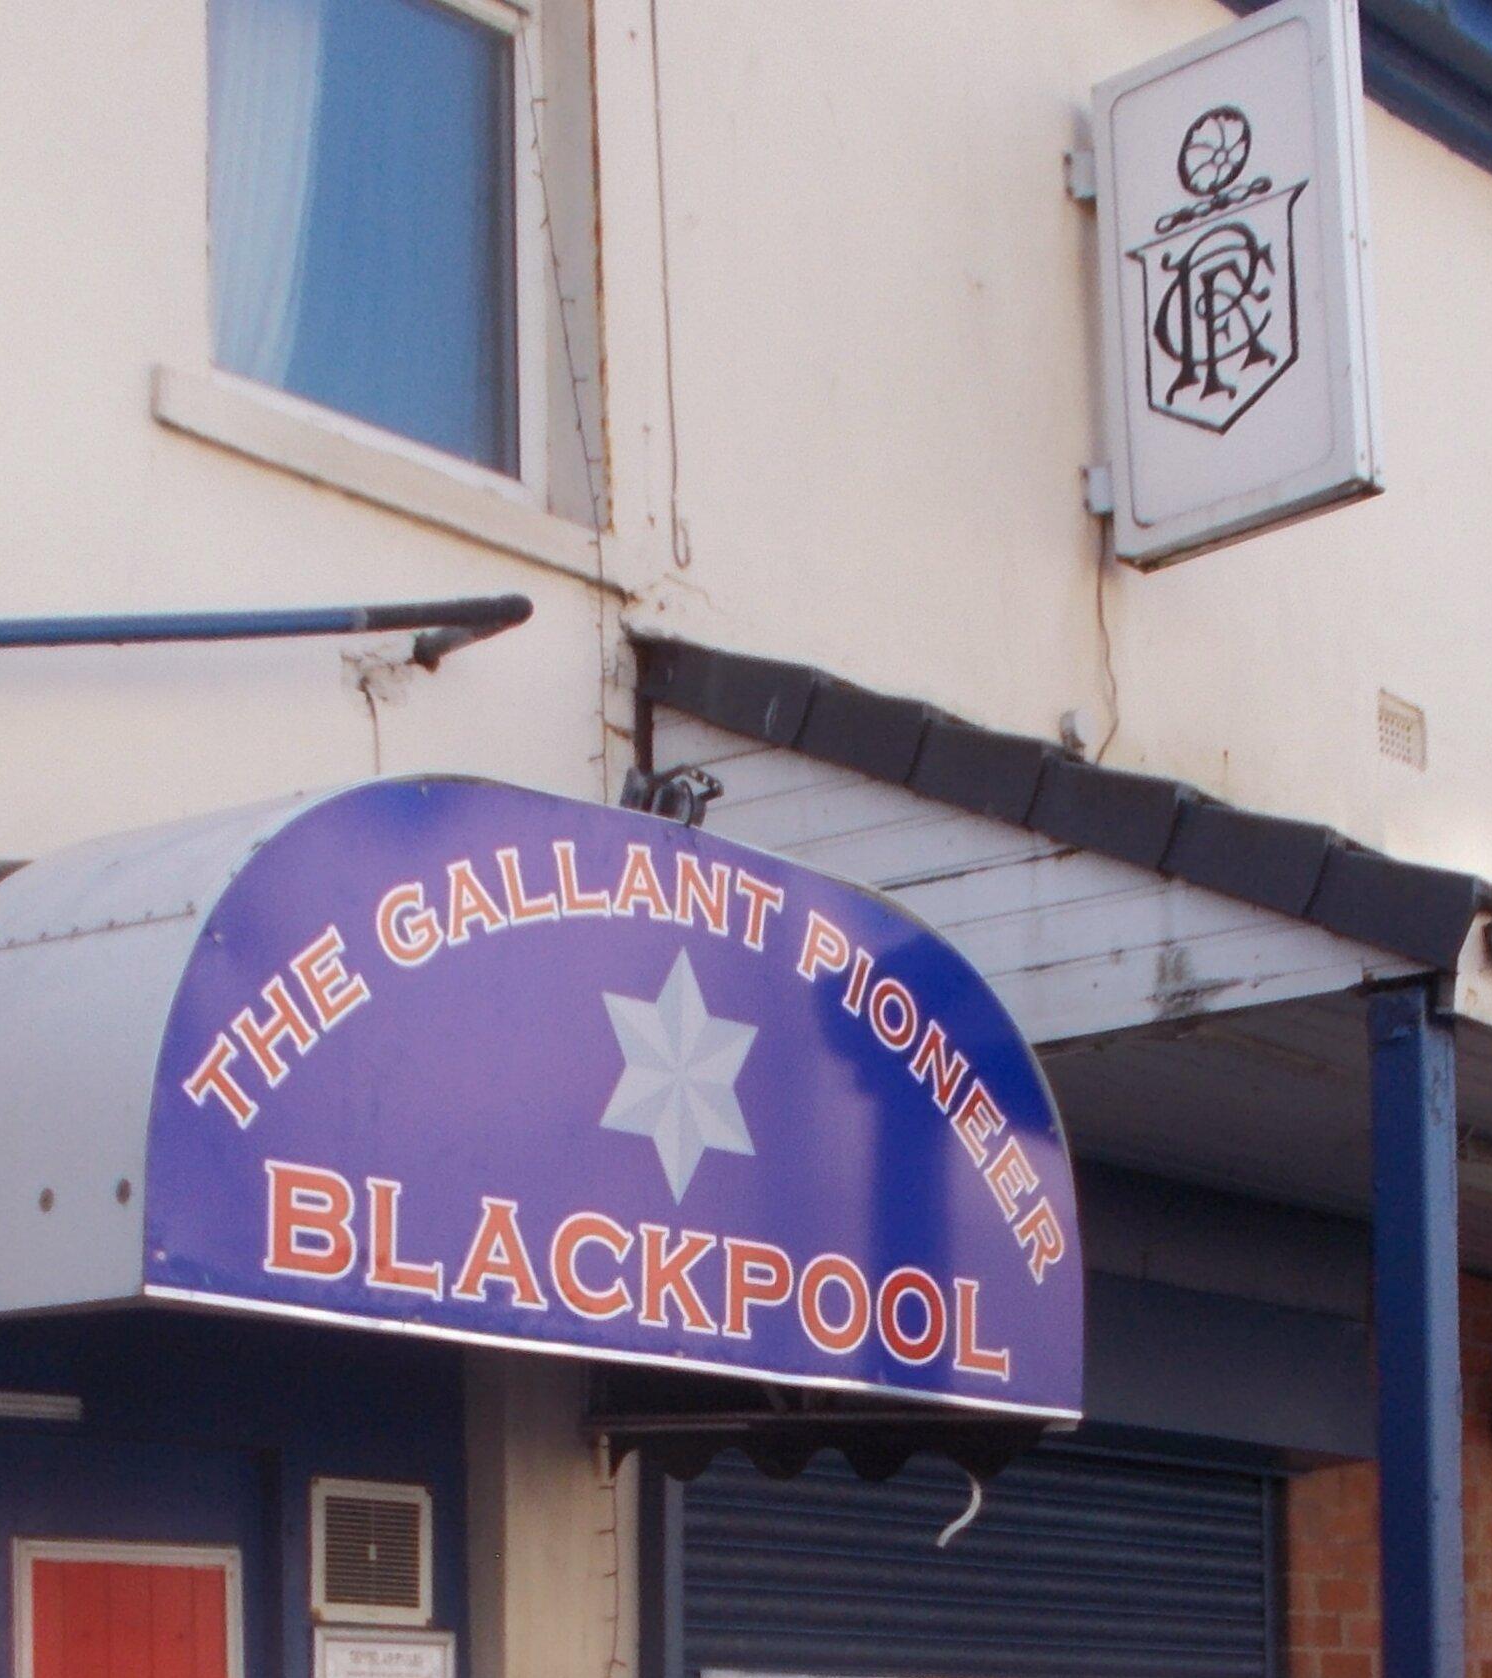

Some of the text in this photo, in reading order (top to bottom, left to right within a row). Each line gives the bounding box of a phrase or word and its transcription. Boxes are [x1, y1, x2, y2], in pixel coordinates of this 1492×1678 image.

[183, 839, 1065, 1285] THE GALLANT PIONEER
[261, 1157, 1012, 1382] BLACKPOOL
